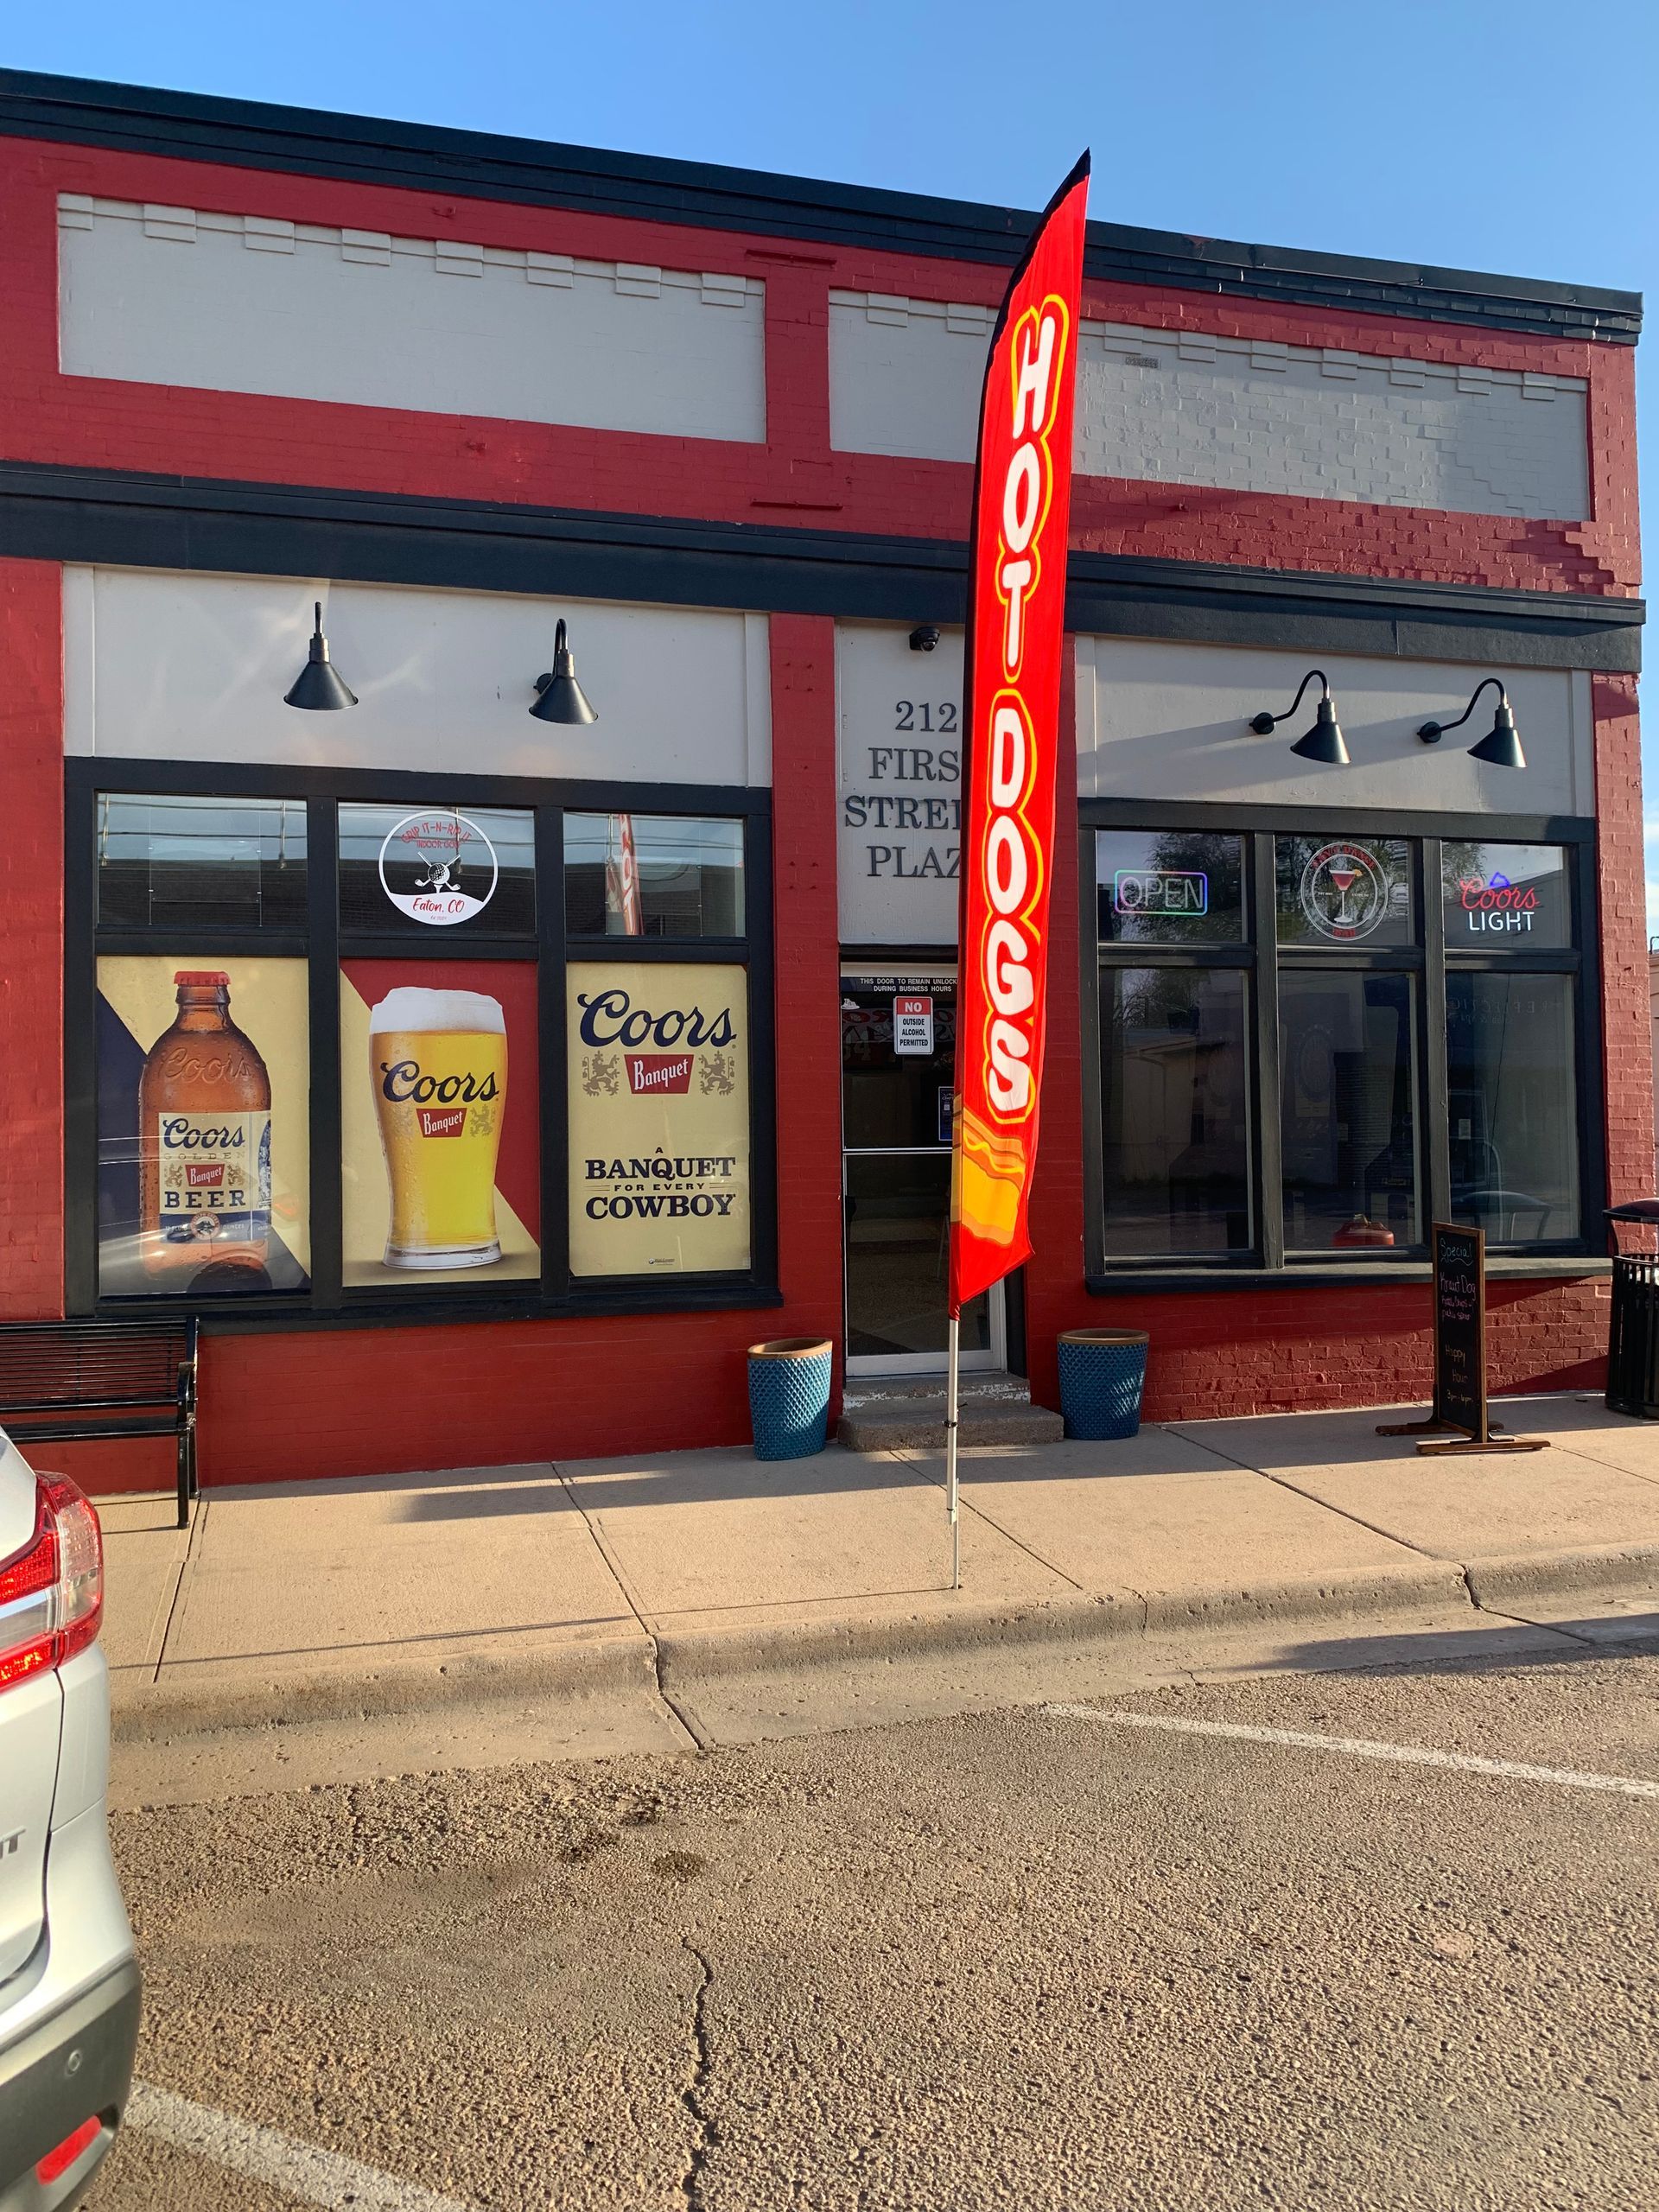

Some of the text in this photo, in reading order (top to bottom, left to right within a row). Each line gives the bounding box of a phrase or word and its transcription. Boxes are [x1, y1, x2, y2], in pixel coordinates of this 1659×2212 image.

[894, 700, 957, 733] 212
[987, 315, 1056, 1113] HOT DOGS
[868, 747, 961, 782] FIRS
[844, 795, 961, 830] STRE
[866, 845, 961, 879] PLAZ
[448, 899, 465, 913] CO
[1120, 876, 1204, 908] OPEN
[1459, 875, 1541, 910] Coors
[1468, 911, 1535, 931] LIGHT
[577, 989, 737, 1047] Coors
[905, 1002, 923, 1013] NO
[158, 1047, 251, 1084] Coors
[633, 1058, 689, 1090] Banquet
[380, 1060, 499, 1103] Coors
[162, 1118, 245, 1148] Coors
[423, 1111, 463, 1135] Banquet
[164, 1152, 245, 1160] GOLDEN
[585, 1157, 736, 1181] BANQUET
[190, 1166, 222, 1185] Banquet
[164, 1190, 246, 1208] BEER
[586, 1194, 736, 1219] COWBOY
[1440, 1237, 1471, 1262] Special
[1461, 1274, 1476, 1301] Dog
[1446, 1341, 1465, 1368] Happy
